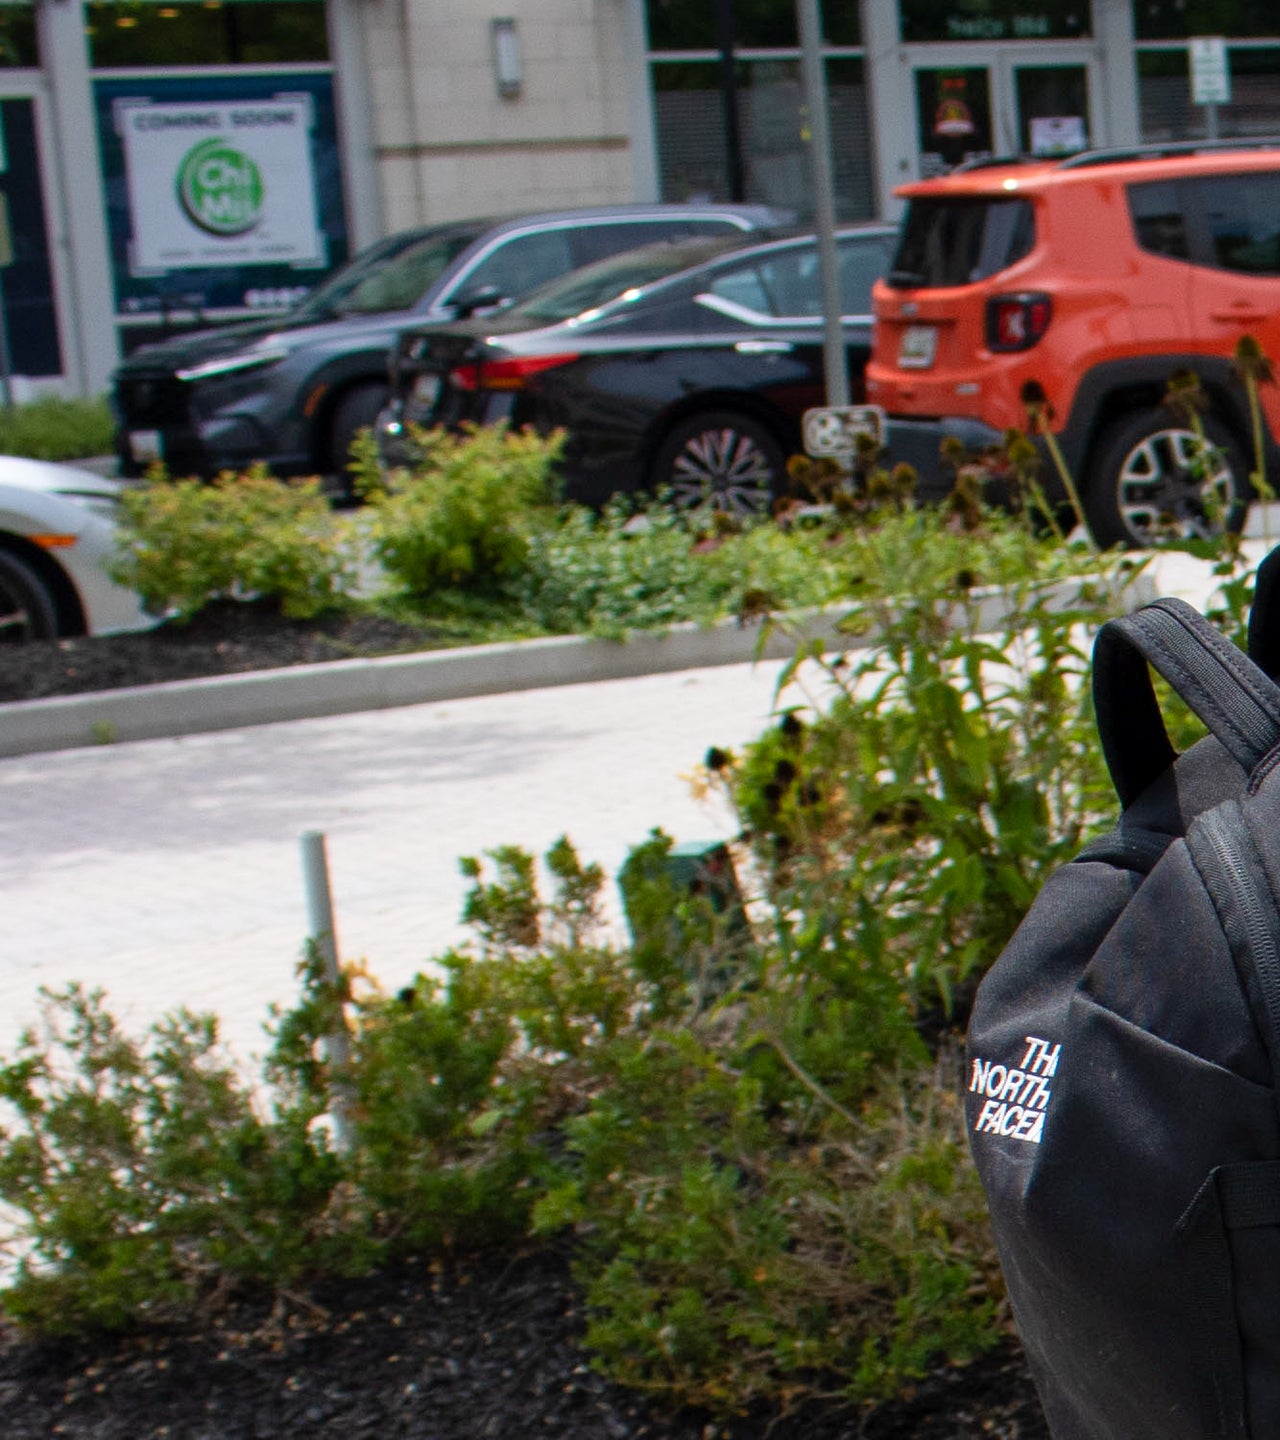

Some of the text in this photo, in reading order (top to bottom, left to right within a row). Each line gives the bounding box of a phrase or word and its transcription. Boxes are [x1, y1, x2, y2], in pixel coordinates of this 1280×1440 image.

[133, 111, 221, 131] COMING
[1019, 1035, 1062, 1078] TH
[968, 1057, 1051, 1111] NORTH
[974, 1099, 1042, 1140] FACE
